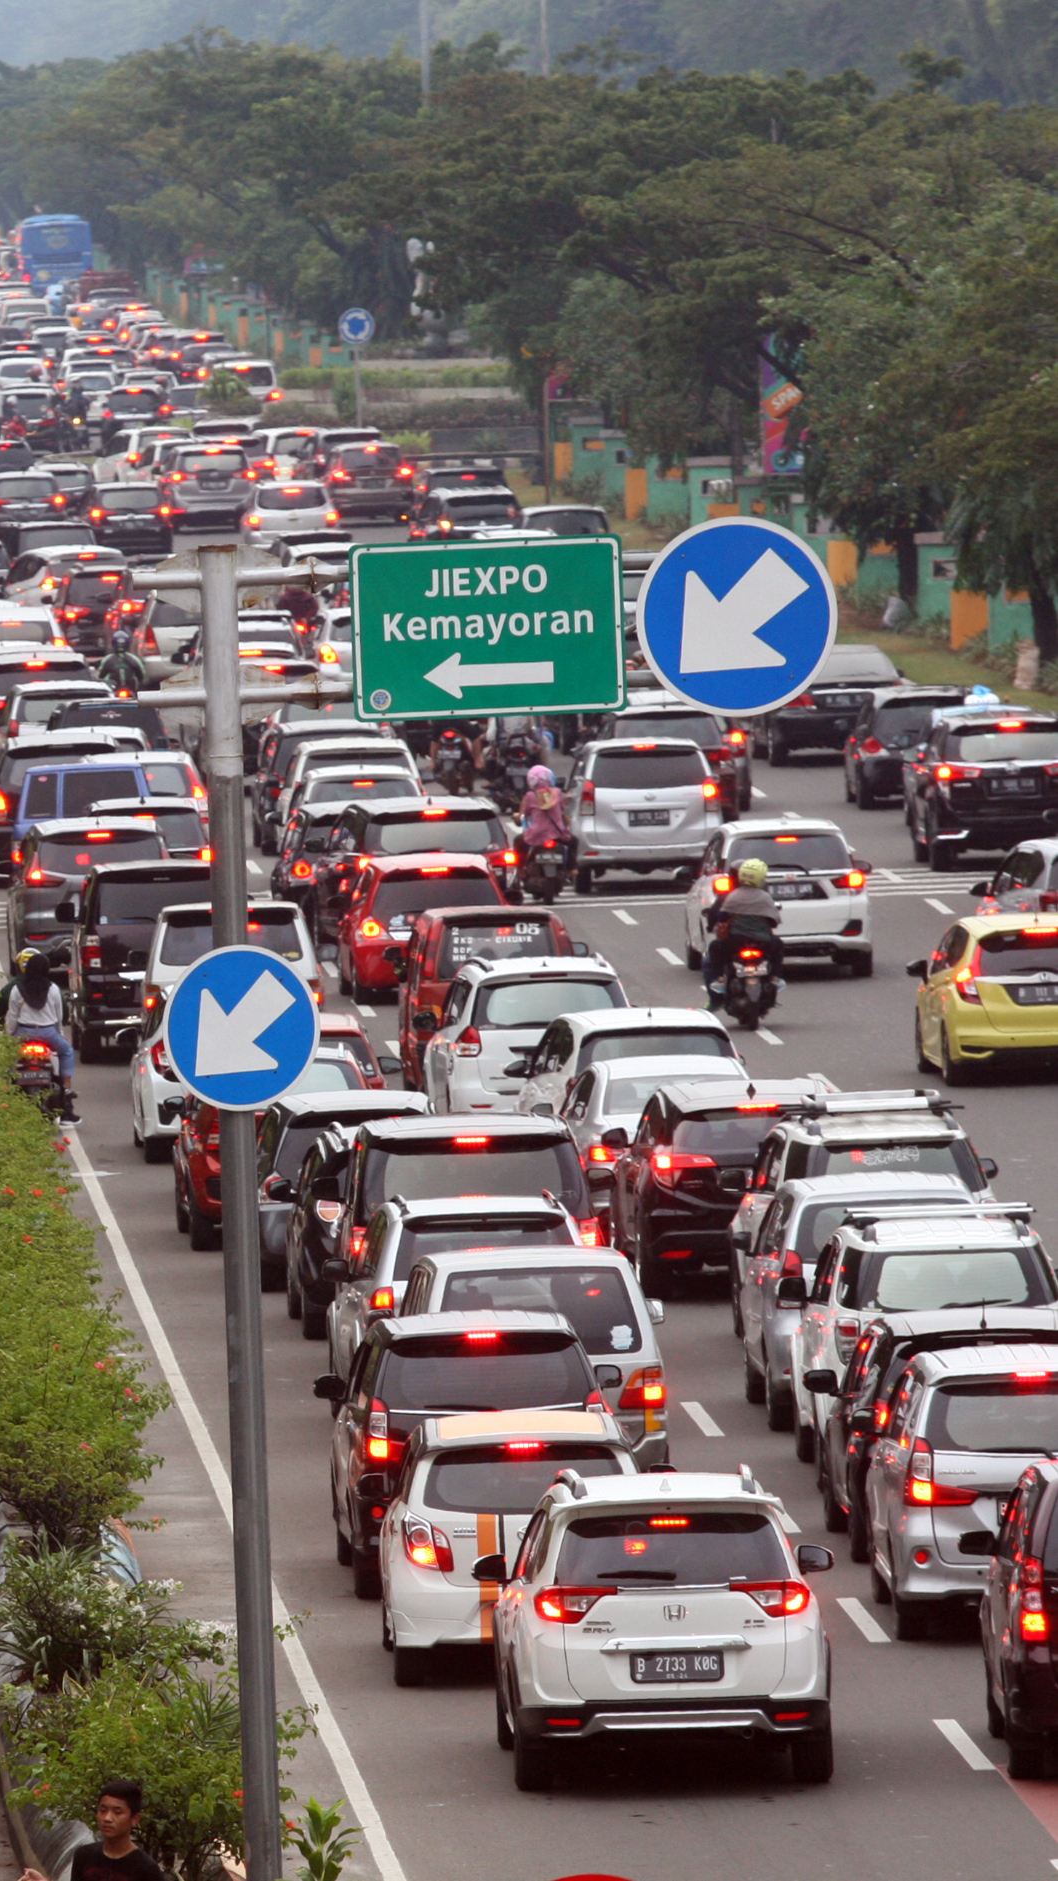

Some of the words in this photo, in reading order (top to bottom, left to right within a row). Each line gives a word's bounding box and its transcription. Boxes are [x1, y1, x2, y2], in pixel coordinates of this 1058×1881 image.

[424, 564, 548, 598] JIEXPO
[383, 609, 594, 645] Kemayoran
[452, 927, 459, 935] 2
[515, 922, 540, 935] 05
[638, 1658, 645, 1672] B
[656, 1657, 687, 1672] 2733
